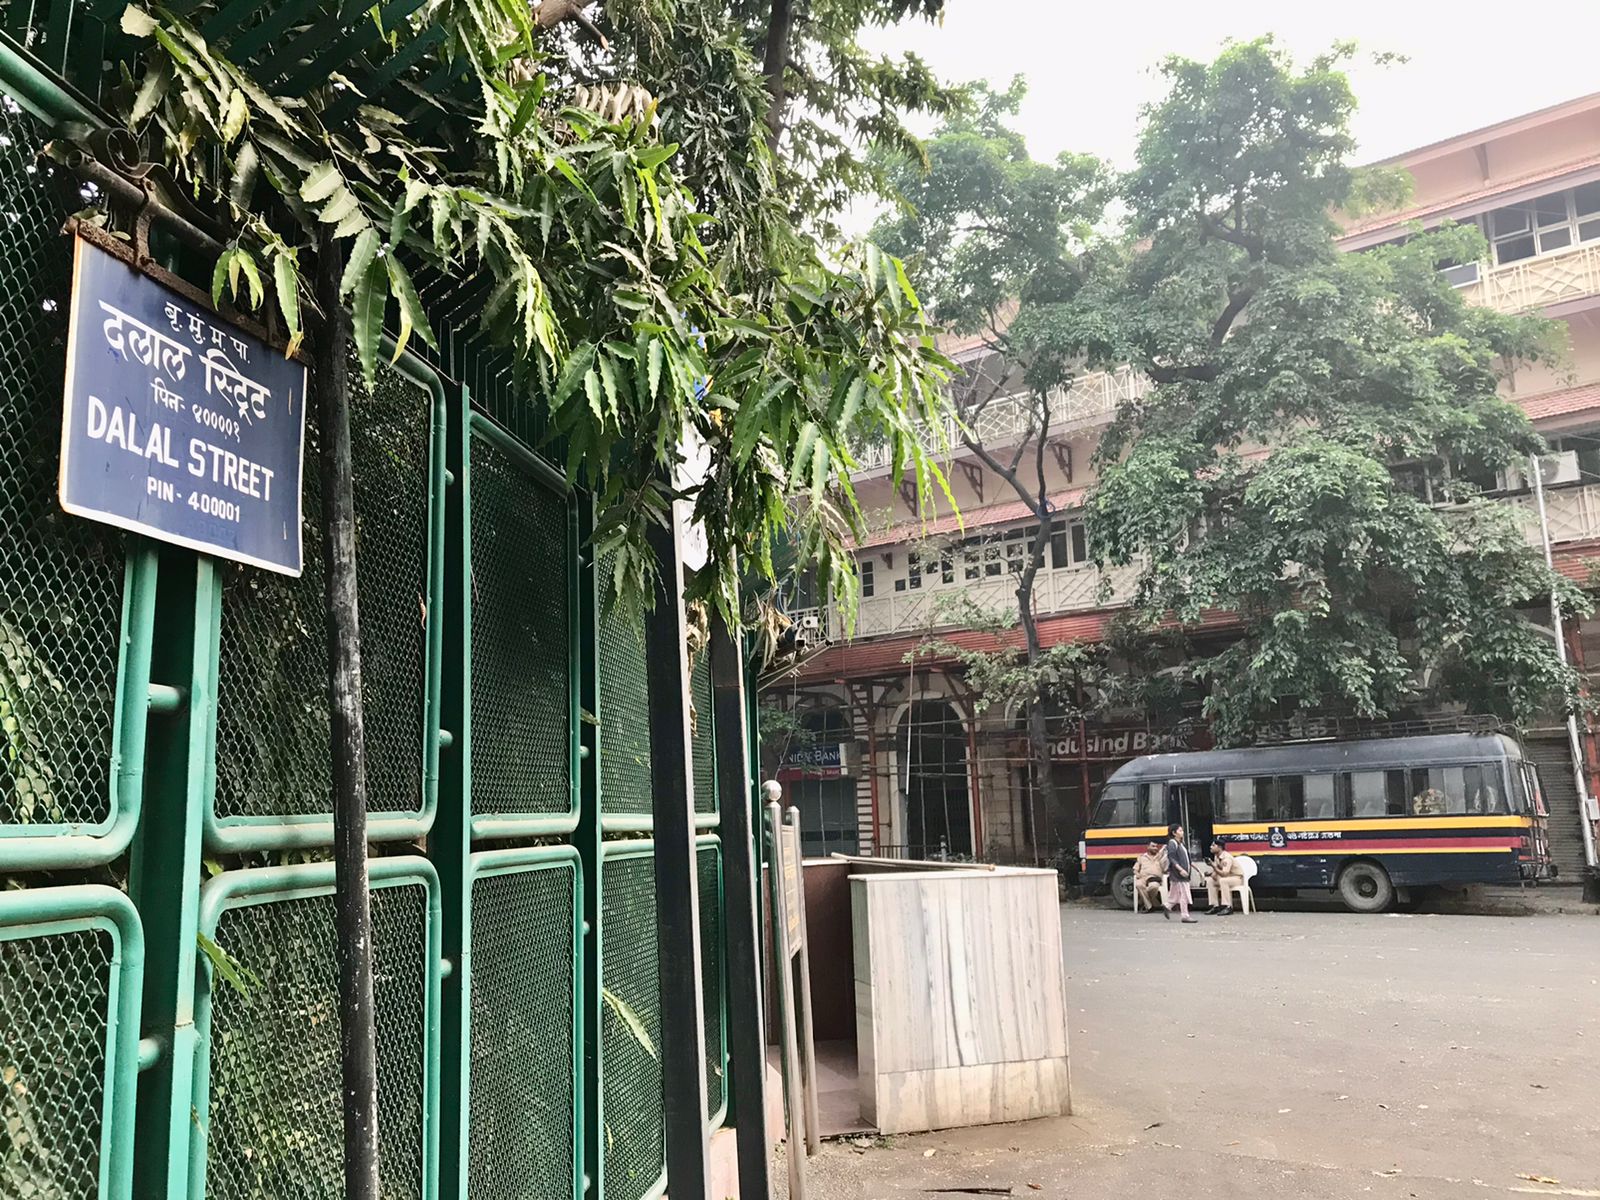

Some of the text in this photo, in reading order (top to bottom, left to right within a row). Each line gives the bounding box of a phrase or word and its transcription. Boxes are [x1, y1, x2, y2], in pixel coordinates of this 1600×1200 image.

[98, 299, 272, 426] दलाल स्ट्रिट
[209, 325, 227, 352] म.
[229, 336, 251, 364] पा.
[192, 403, 241, 443] ४००००१
[87, 396, 274, 502] DALAL STREET
[188, 491, 240, 523] 400001
[1046, 731, 1129, 755] ndusInd
